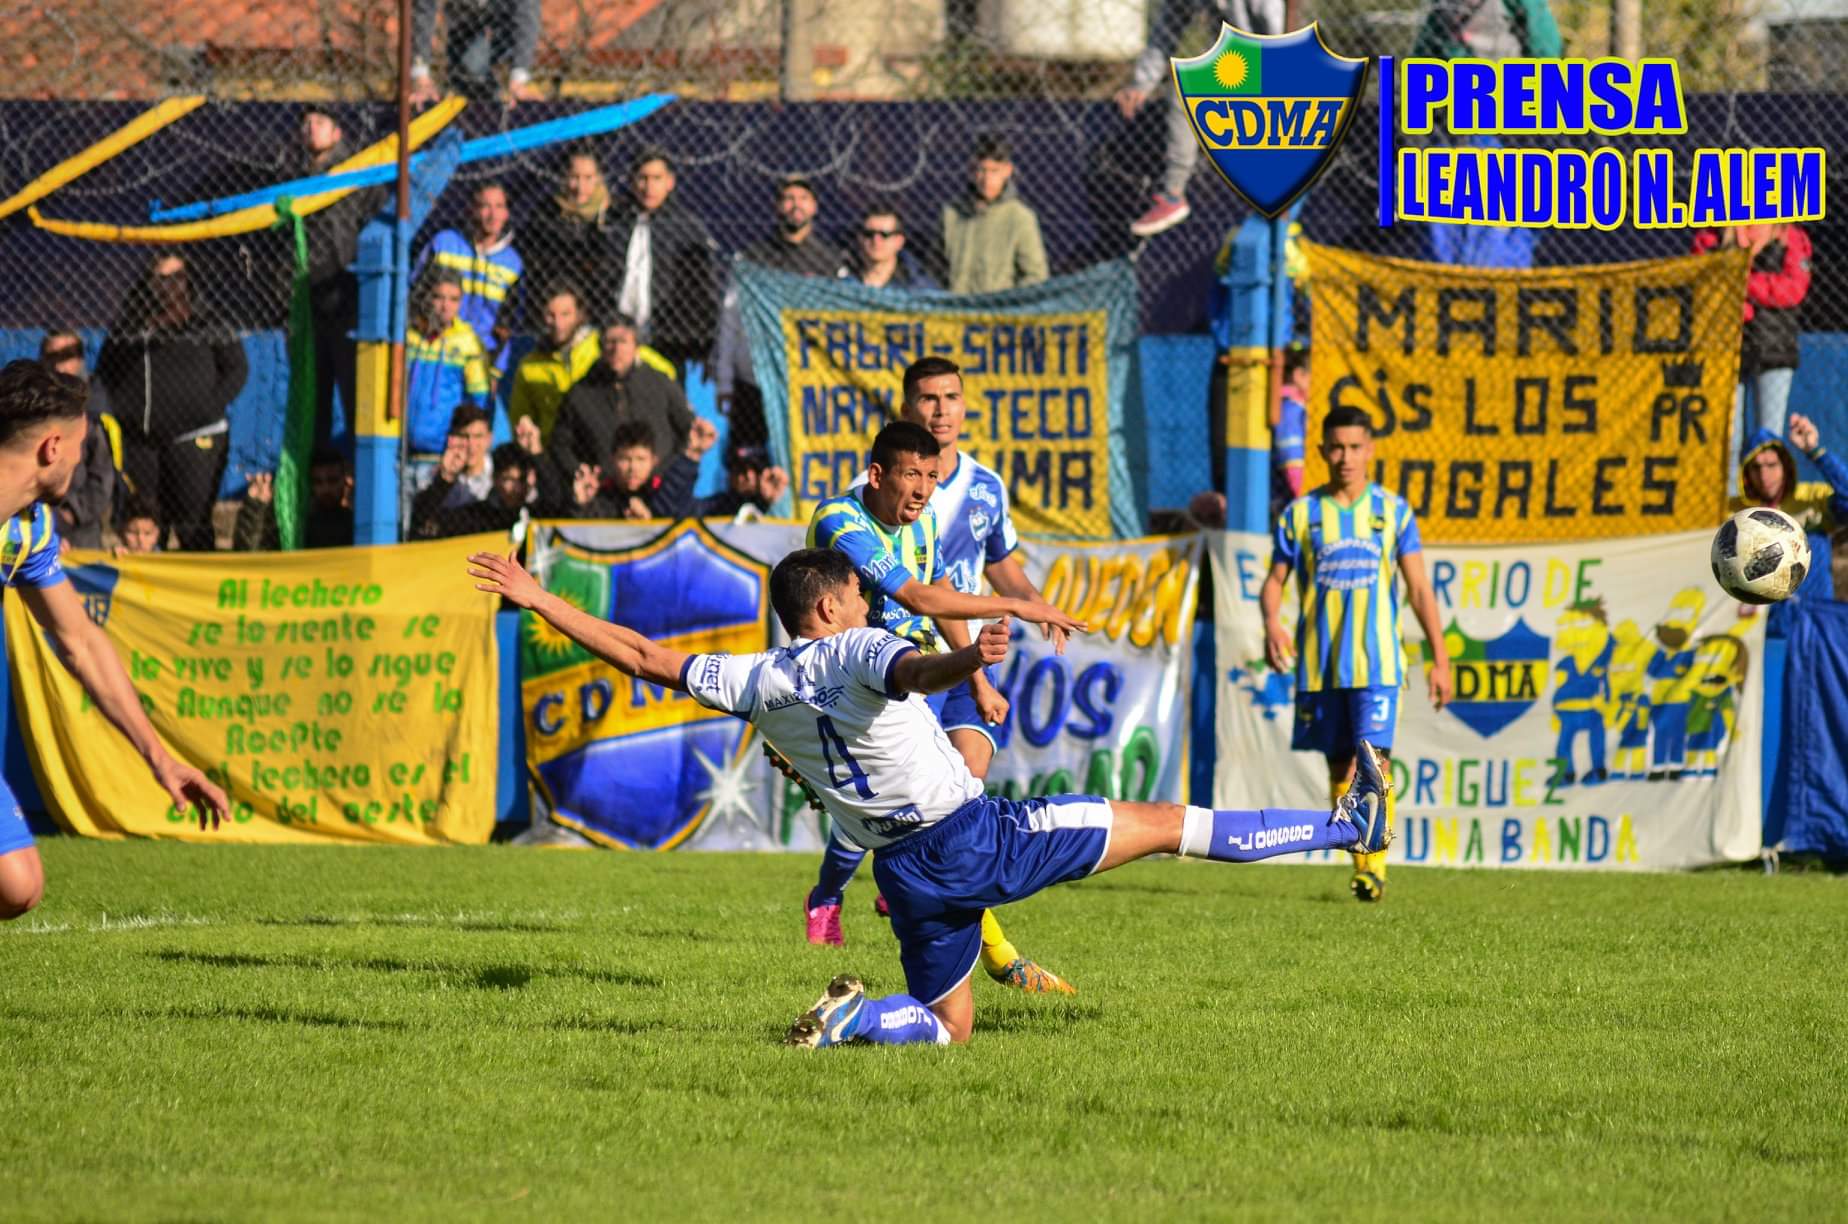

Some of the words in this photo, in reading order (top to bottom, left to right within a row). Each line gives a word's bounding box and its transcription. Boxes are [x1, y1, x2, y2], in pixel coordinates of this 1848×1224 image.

[1356, 284, 1694, 357] MARIO
[1465, 375, 1598, 436] LOS
[1650, 392, 1710, 445] PR
[1375, 455, 1679, 519] OGALES
[1541, 556, 1603, 608] DE
[237, 615, 265, 645] lo
[326, 647, 354, 678] lo
[1453, 664, 1538, 699] DMA
[433, 681, 464, 714] lo
[1371, 695, 1390, 722] 3
[817, 714, 879, 799] 4
[1392, 757, 1566, 807] DRIGUEZ
[1405, 817, 1484, 863] UNA
[1501, 815, 1640, 863] BANDA
